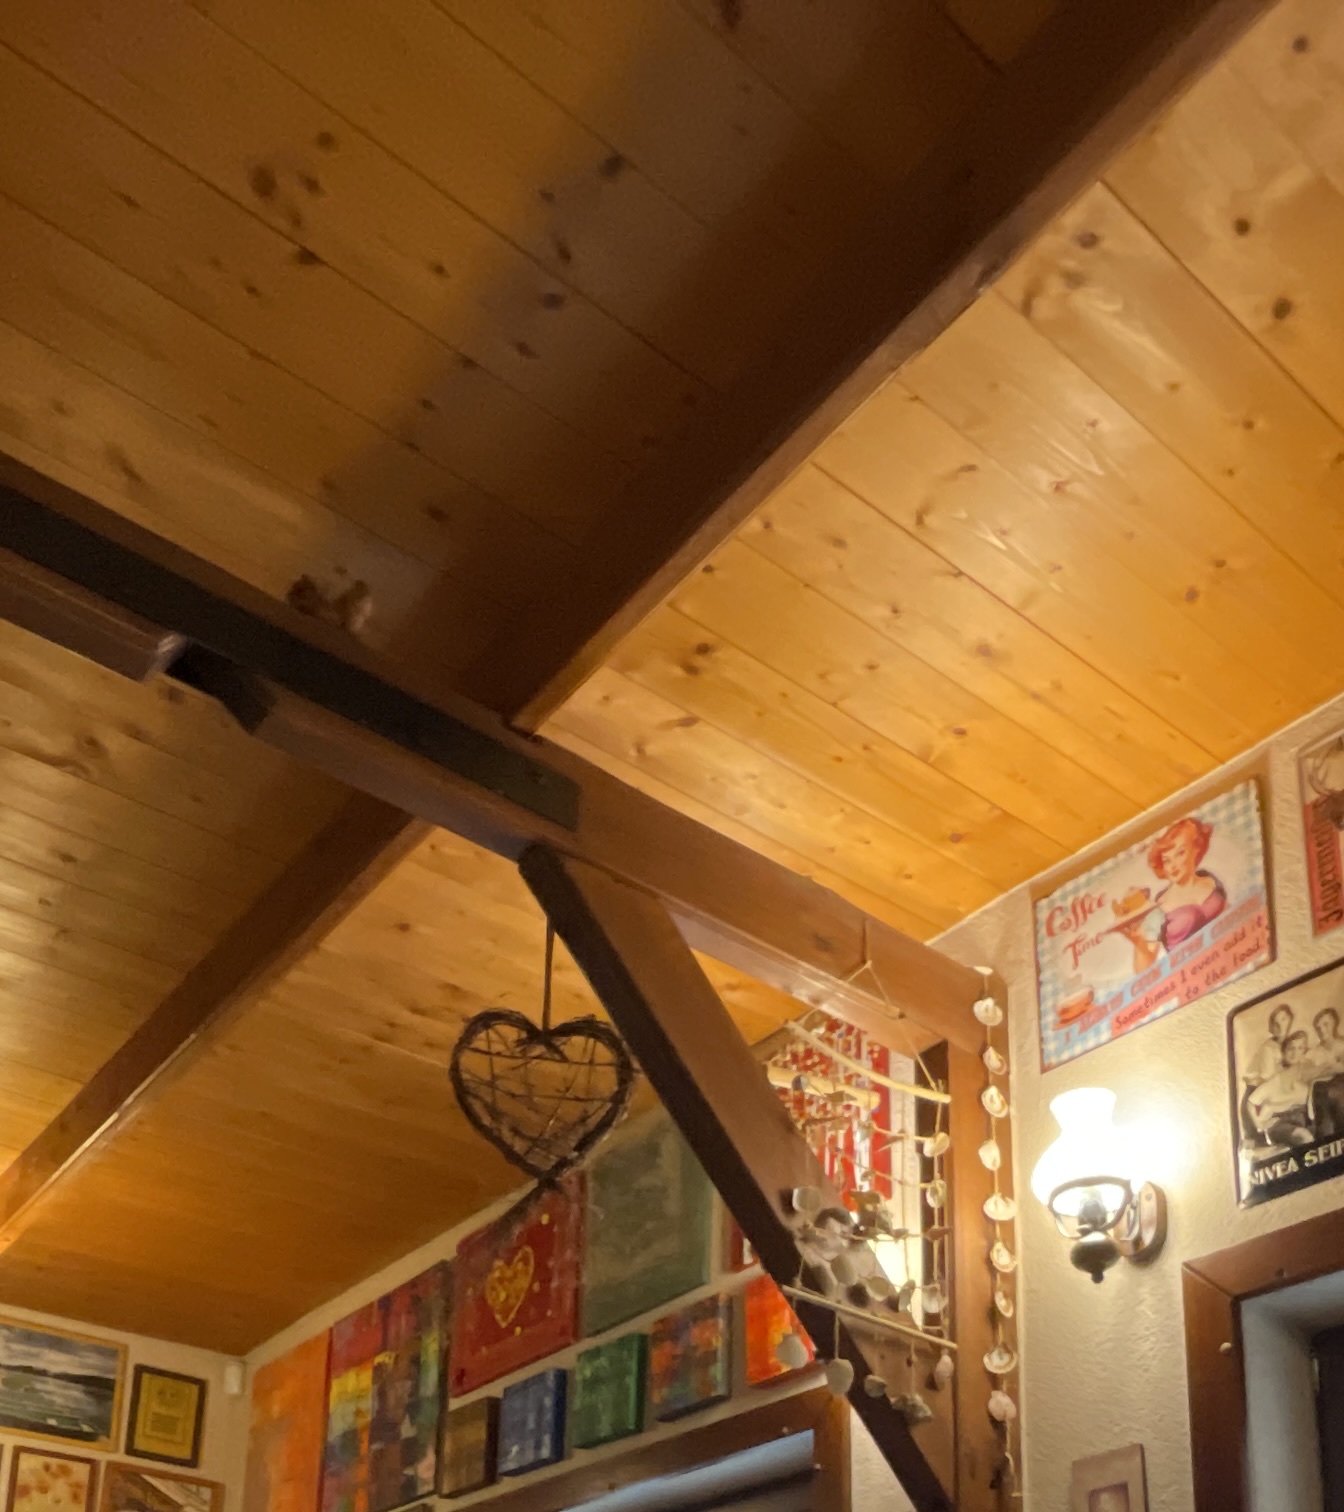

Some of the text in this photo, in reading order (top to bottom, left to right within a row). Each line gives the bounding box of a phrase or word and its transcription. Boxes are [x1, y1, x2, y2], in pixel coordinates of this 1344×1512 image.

[1045, 892, 1107, 938] Coffee
[1063, 930, 1104, 971] Time
[1115, 982, 1176, 1031] Sometimes
[1190, 951, 1219, 976] even
[1223, 926, 1246, 952] add
[1185, 983, 1200, 1000] to
[1204, 964, 1227, 986] the
[1249, 1156, 1300, 1185] NIVEA
